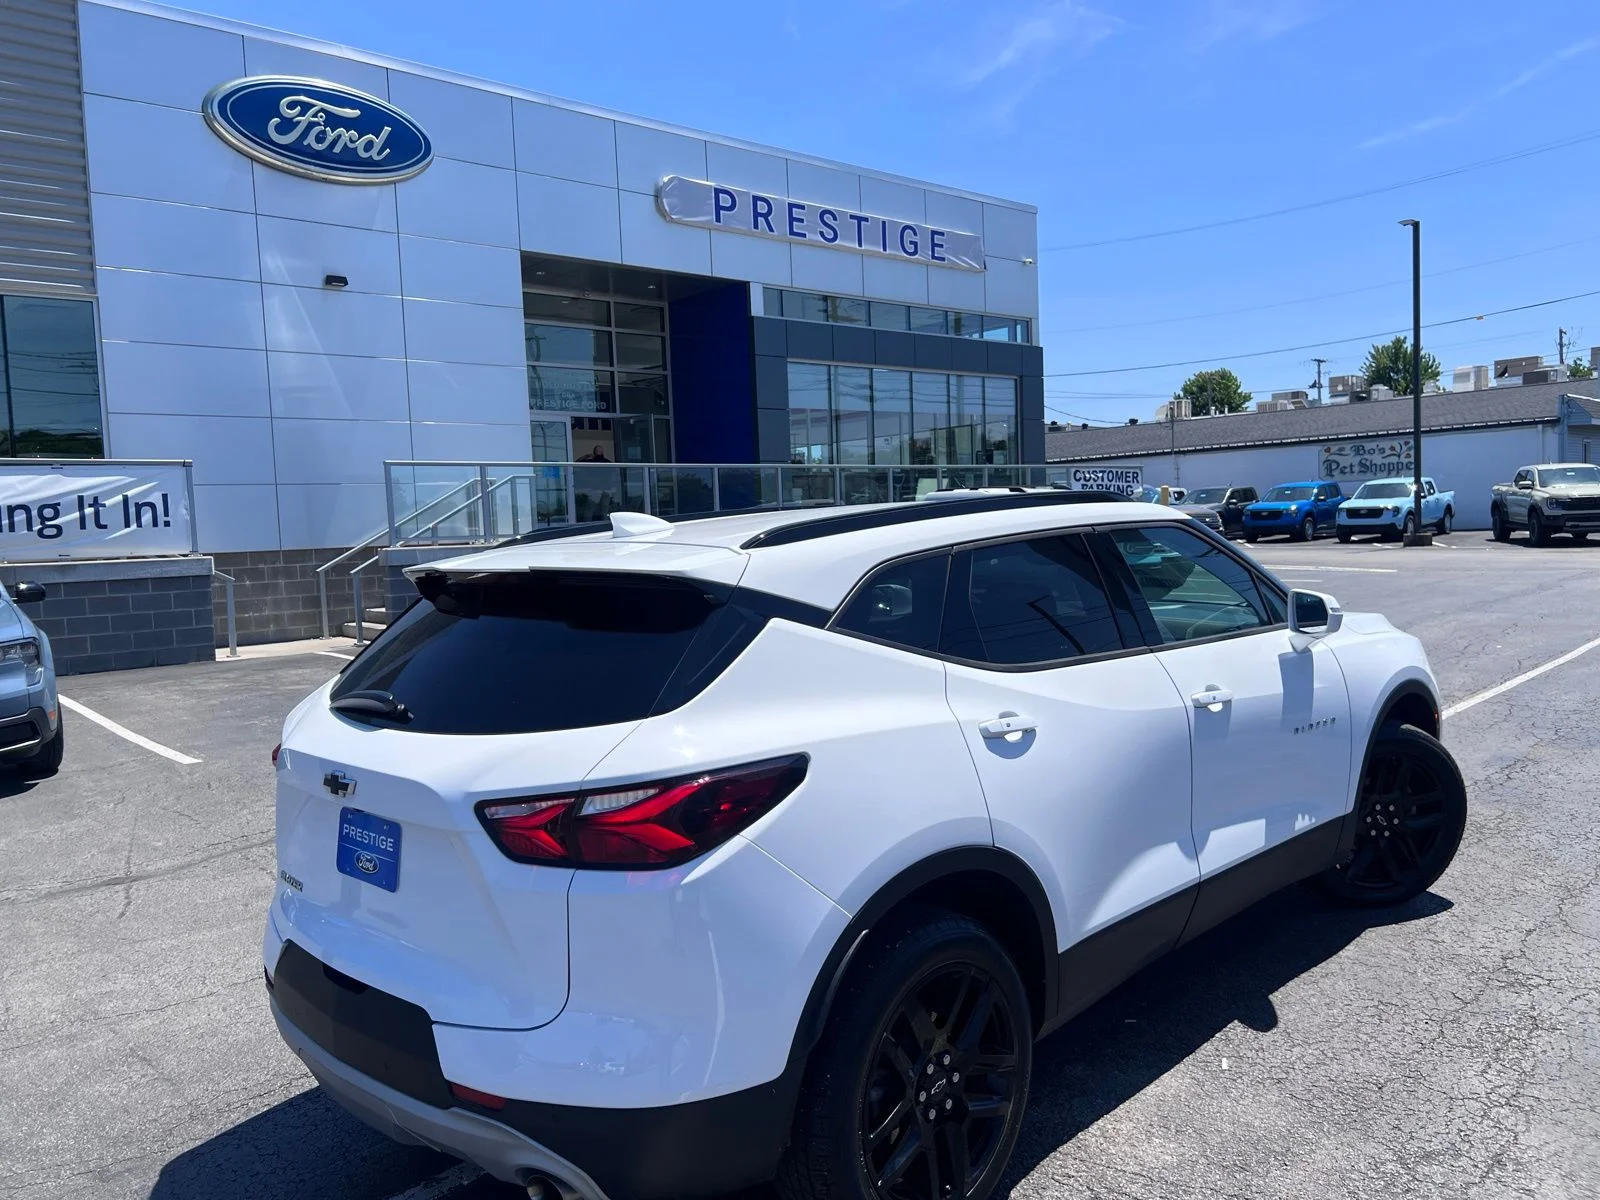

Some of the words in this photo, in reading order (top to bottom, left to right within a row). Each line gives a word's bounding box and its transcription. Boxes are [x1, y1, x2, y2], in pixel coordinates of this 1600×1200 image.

[267, 95, 392, 161] Ford
[712, 186, 947, 263] PRESTIGE
[1350, 444, 1386, 458] Bo's
[1073, 469, 1139, 484] CUSTOMER
[1322, 459, 1355, 477] Pet
[1358, 457, 1415, 477] Shoppe
[77, 495, 108, 530] It
[121, 493, 171, 529] In!
[342, 823, 394, 852] PRESTIGE
[358, 853, 375, 870] Ford
